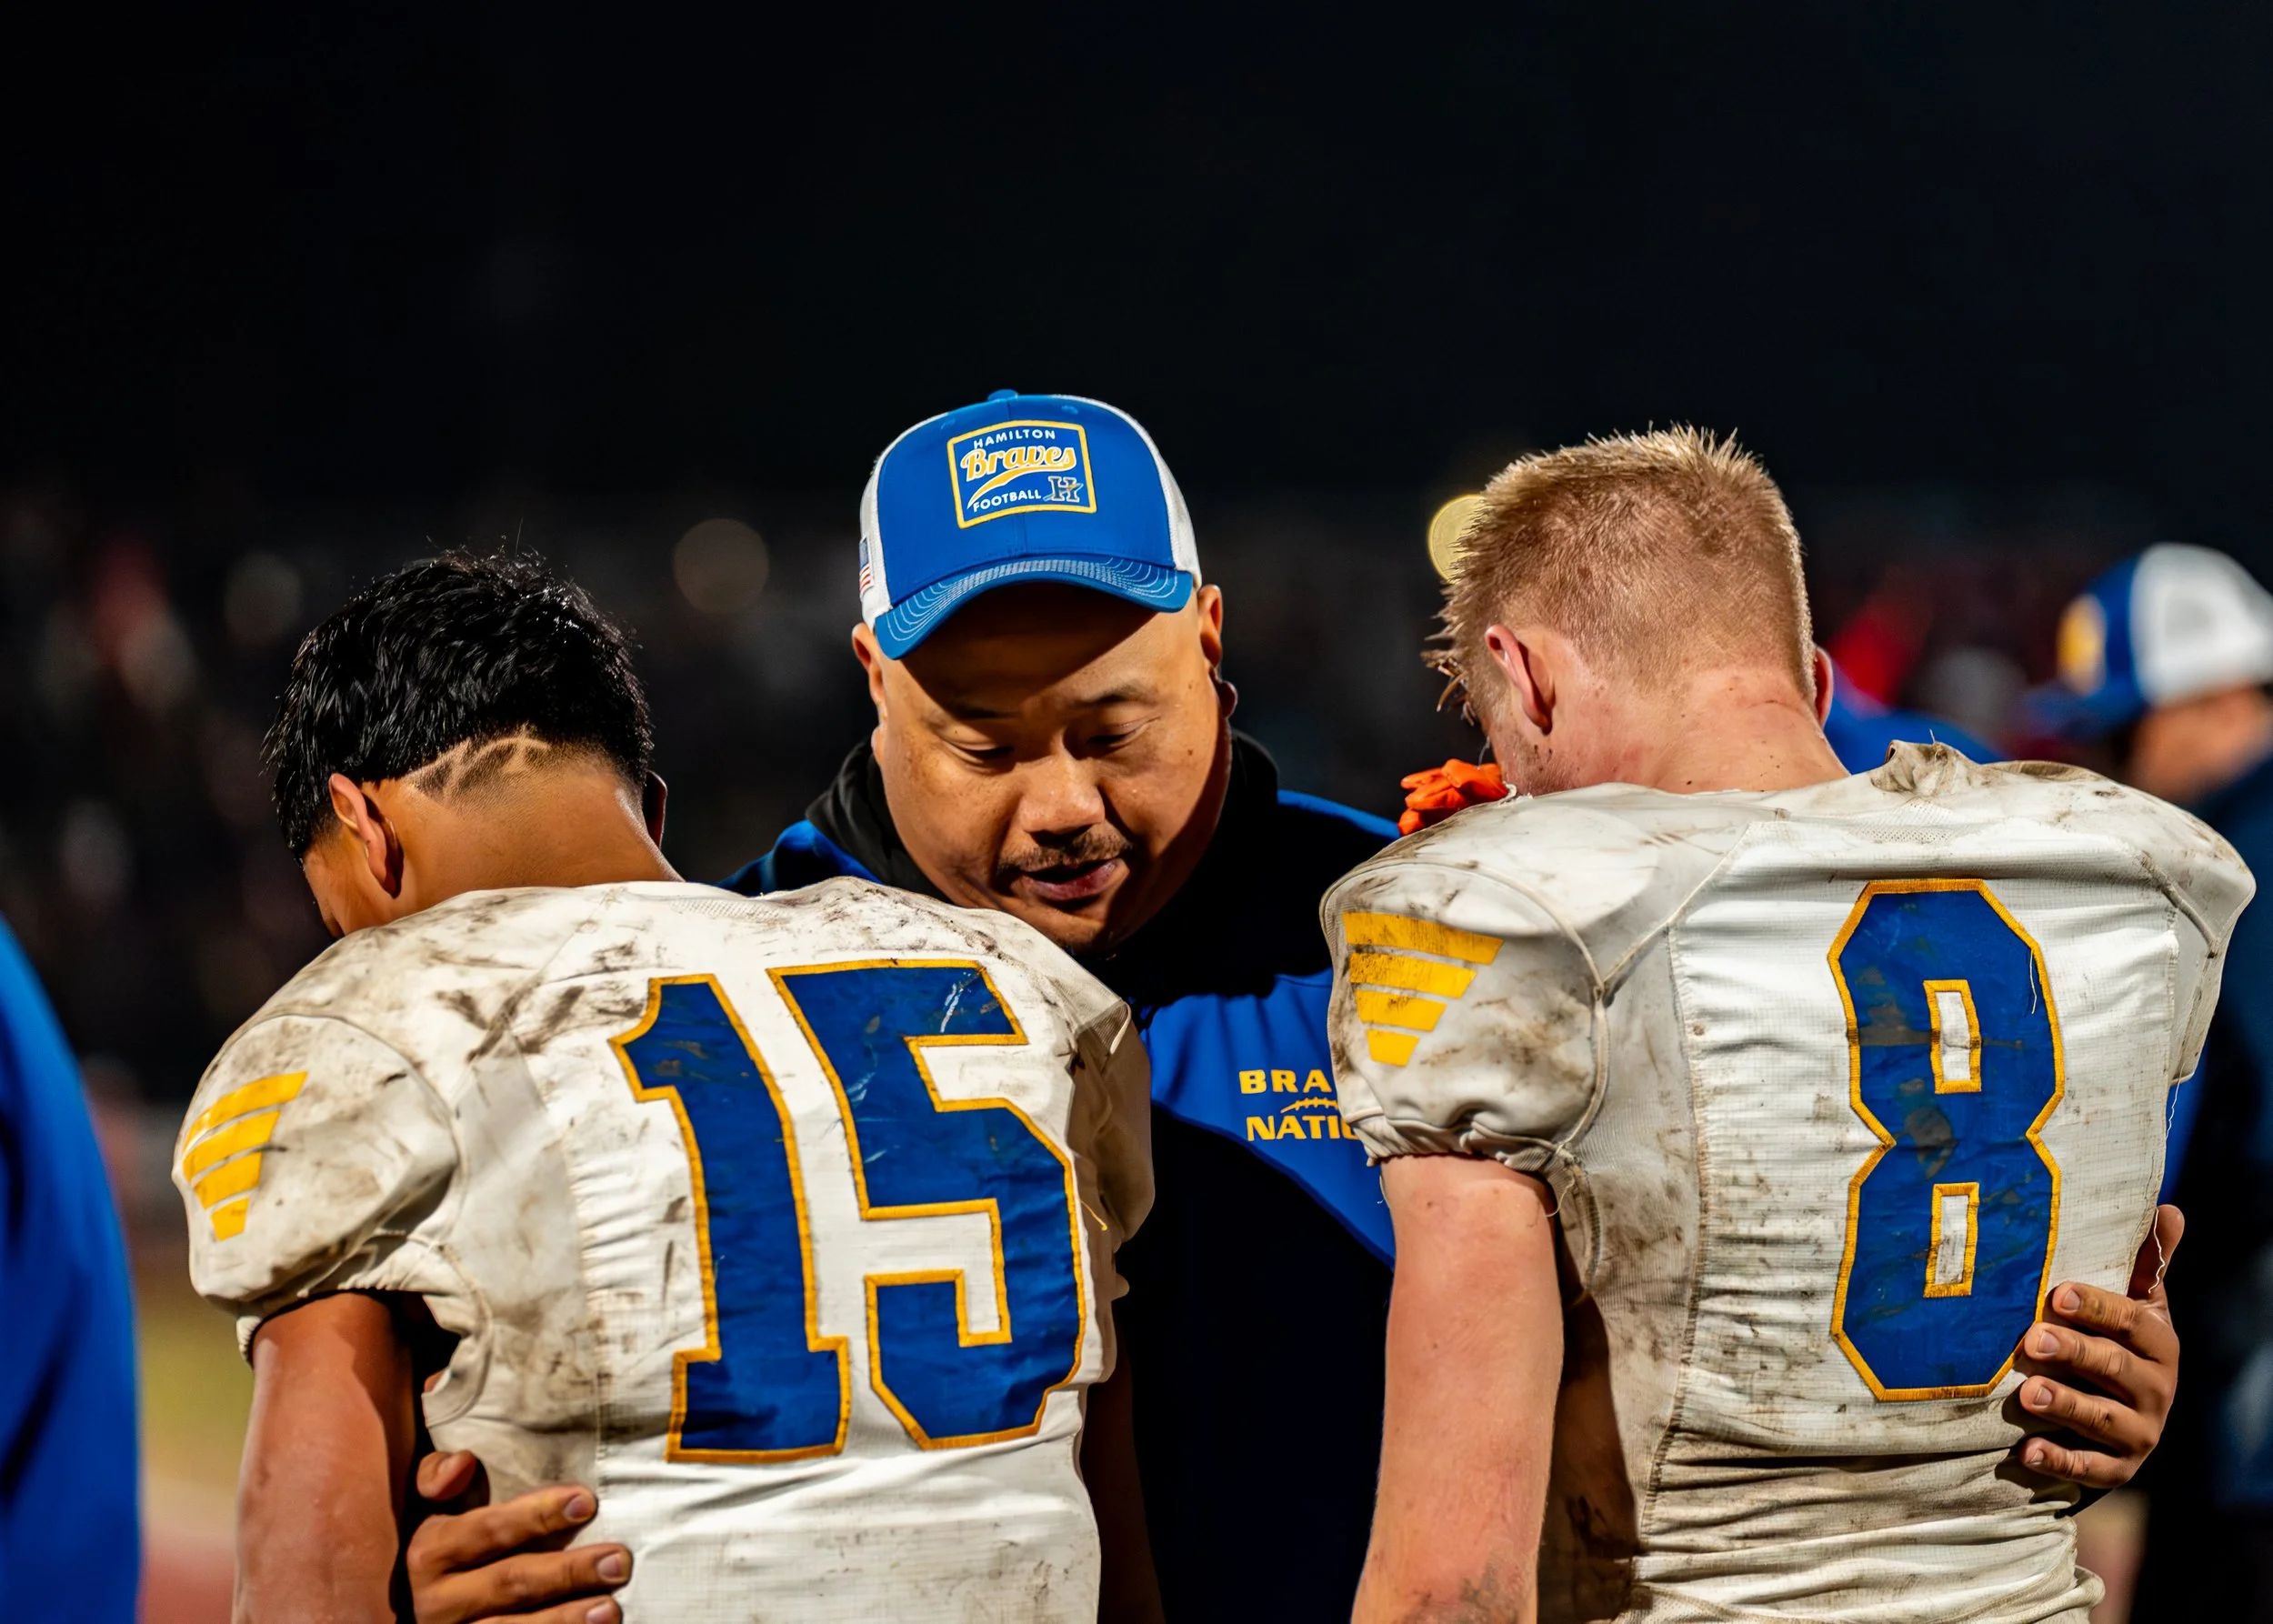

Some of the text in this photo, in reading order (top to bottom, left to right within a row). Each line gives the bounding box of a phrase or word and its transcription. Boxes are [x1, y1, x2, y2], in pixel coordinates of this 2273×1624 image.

[973, 429, 1056, 449] HAMILTON
[960, 445, 1076, 482] Braves
[973, 489, 1041, 512] FOOTBALL
[1047, 476, 1080, 502] H
[1827, 878, 2065, 1401] 8
[608, 958, 1086, 1463] 15
